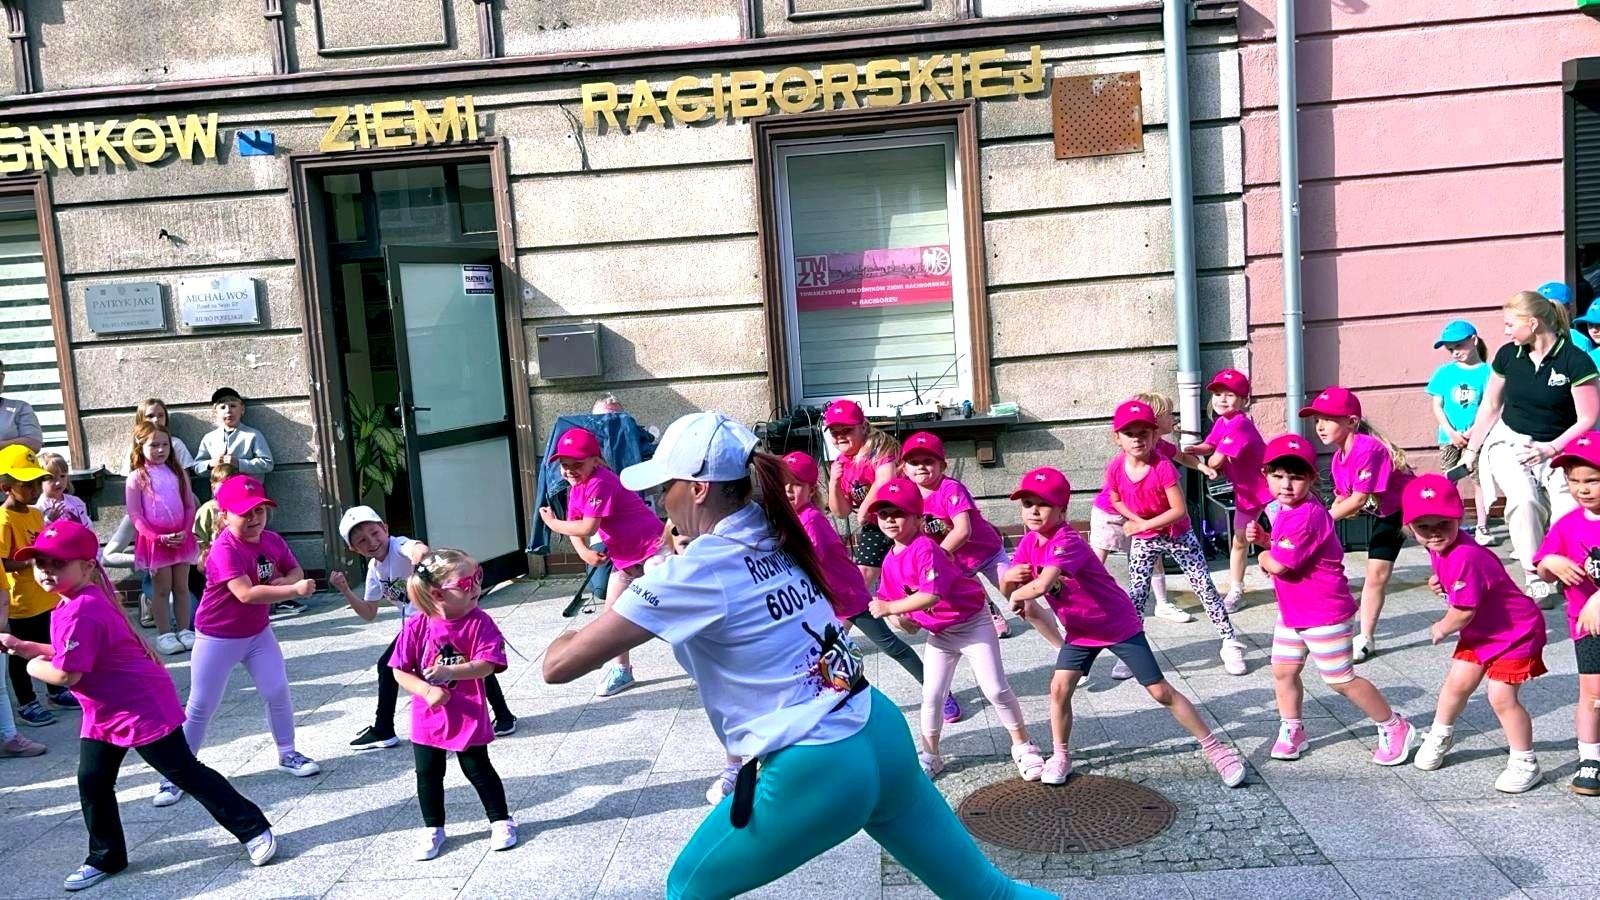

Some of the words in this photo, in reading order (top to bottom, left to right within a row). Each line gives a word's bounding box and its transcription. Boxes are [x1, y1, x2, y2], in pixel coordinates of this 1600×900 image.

[314, 95, 479, 152] ZIEMI
[581, 45, 1046, 129] RACIBORSKIEJ
[92, 298, 132, 309] PATRYK
[133, 296, 155, 307] JAKI
[859, 296, 898, 306] RACIBORZU
